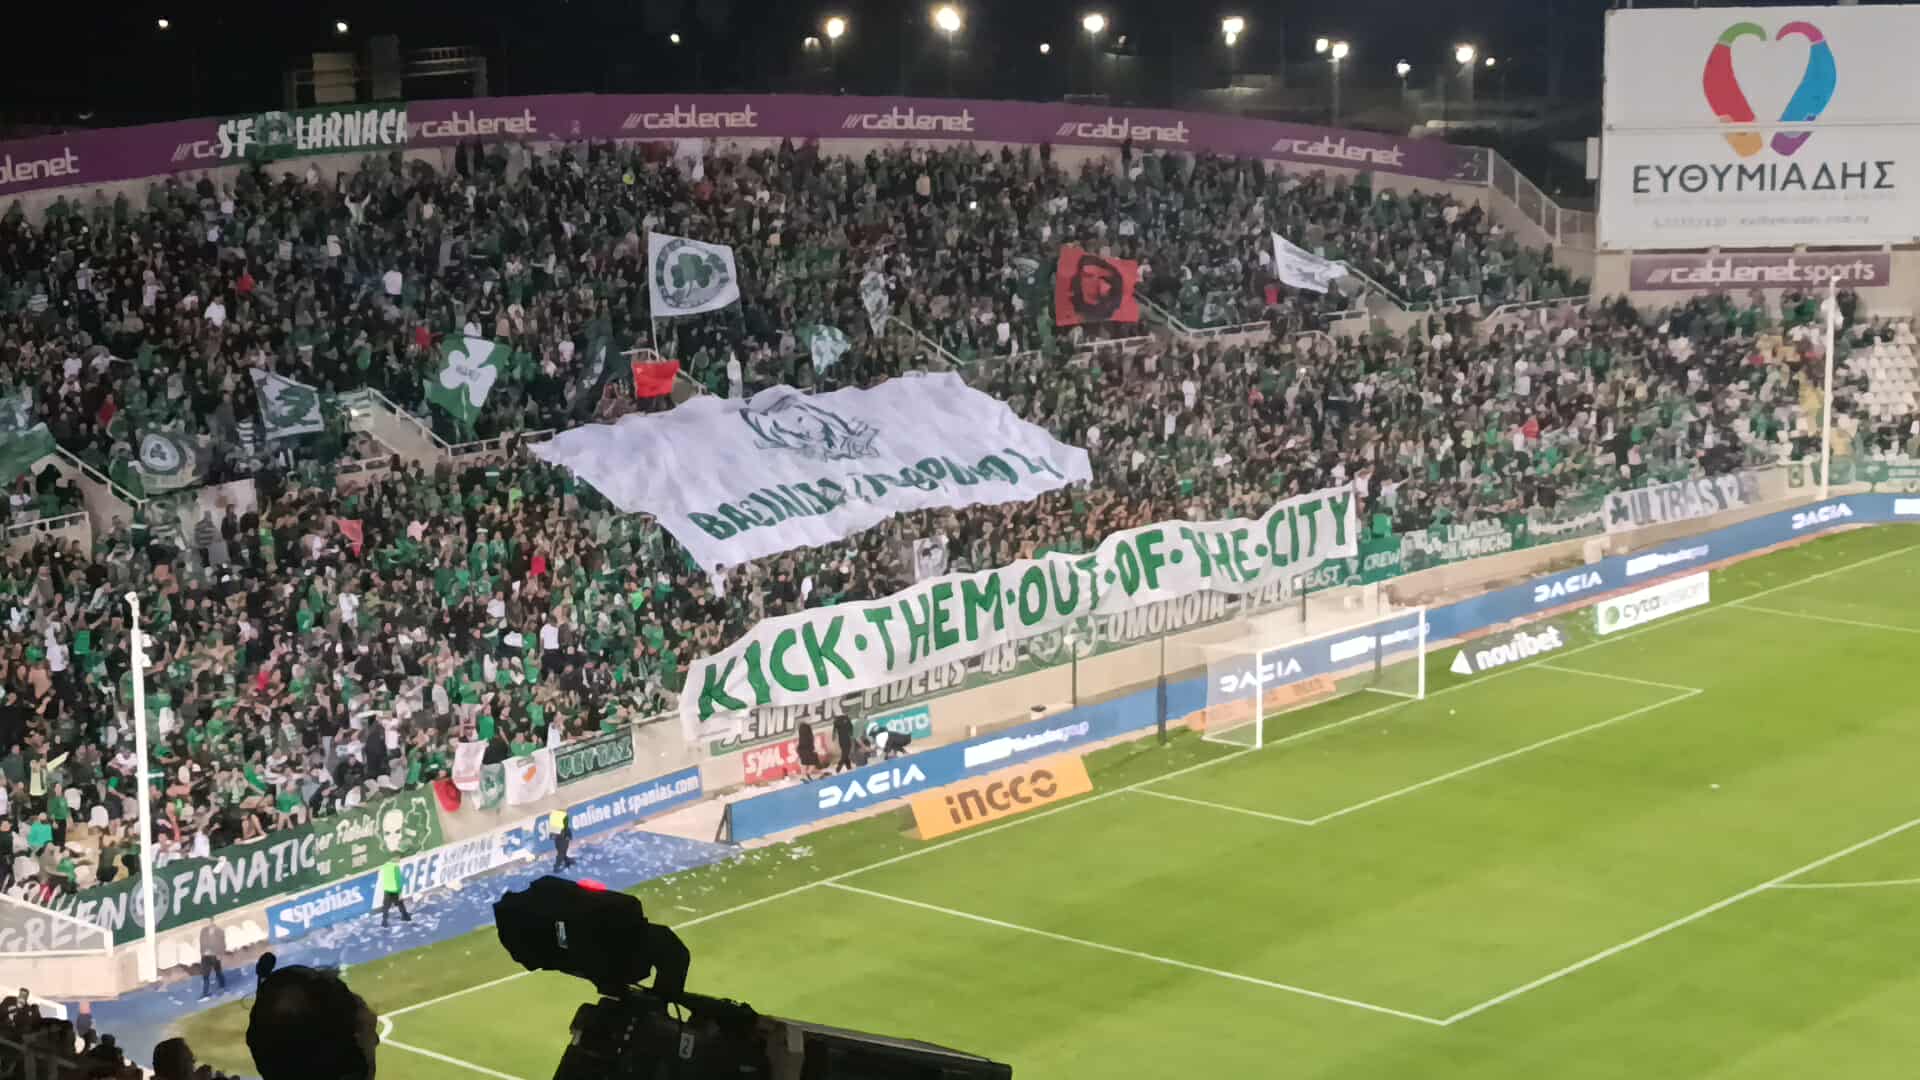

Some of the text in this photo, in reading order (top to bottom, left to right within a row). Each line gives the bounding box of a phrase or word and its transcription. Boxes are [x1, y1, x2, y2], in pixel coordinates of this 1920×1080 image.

[296, 108, 408, 150] LARNACA
[421, 108, 537, 137] cablenet
[643, 103, 758, 130] cablenet
[862, 106, 974, 132] cablenet
[1077, 115, 1189, 143] cablenet
[1291, 135, 1405, 167] cablenet
[1633, 161, 1896, 194] ΕΥΘΥΜΙΑΔΗΣ
[1792, 502, 1854, 530] DACIA
[1533, 570, 1603, 603] DACIA
[698, 490, 1351, 722] KICK THEM OUT OF THE CITY
[1475, 625, 1563, 671] novibet
[818, 764, 926, 809] DACIA
